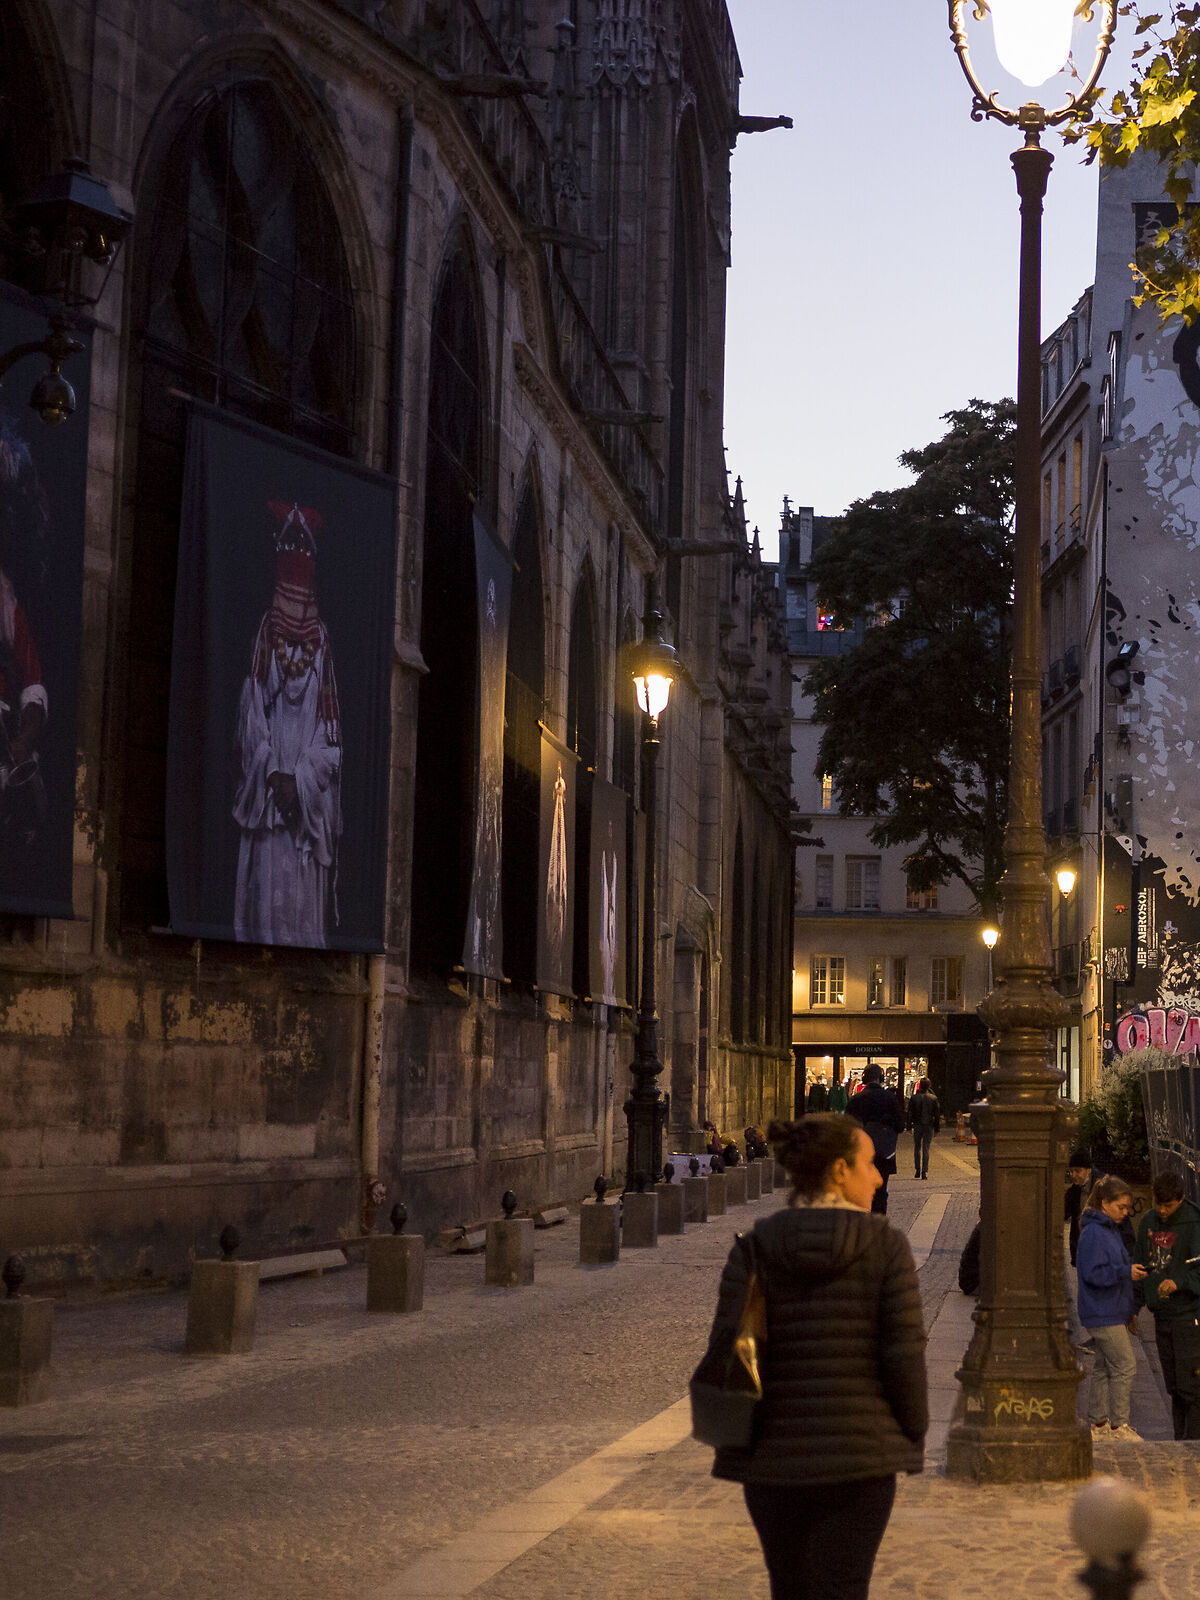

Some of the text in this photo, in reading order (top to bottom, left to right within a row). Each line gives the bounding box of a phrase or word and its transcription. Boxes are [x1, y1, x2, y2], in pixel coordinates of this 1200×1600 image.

[1137, 888, 1147, 969] JEF AEROSOL
[855, 1046, 883, 1054] DORIAN
